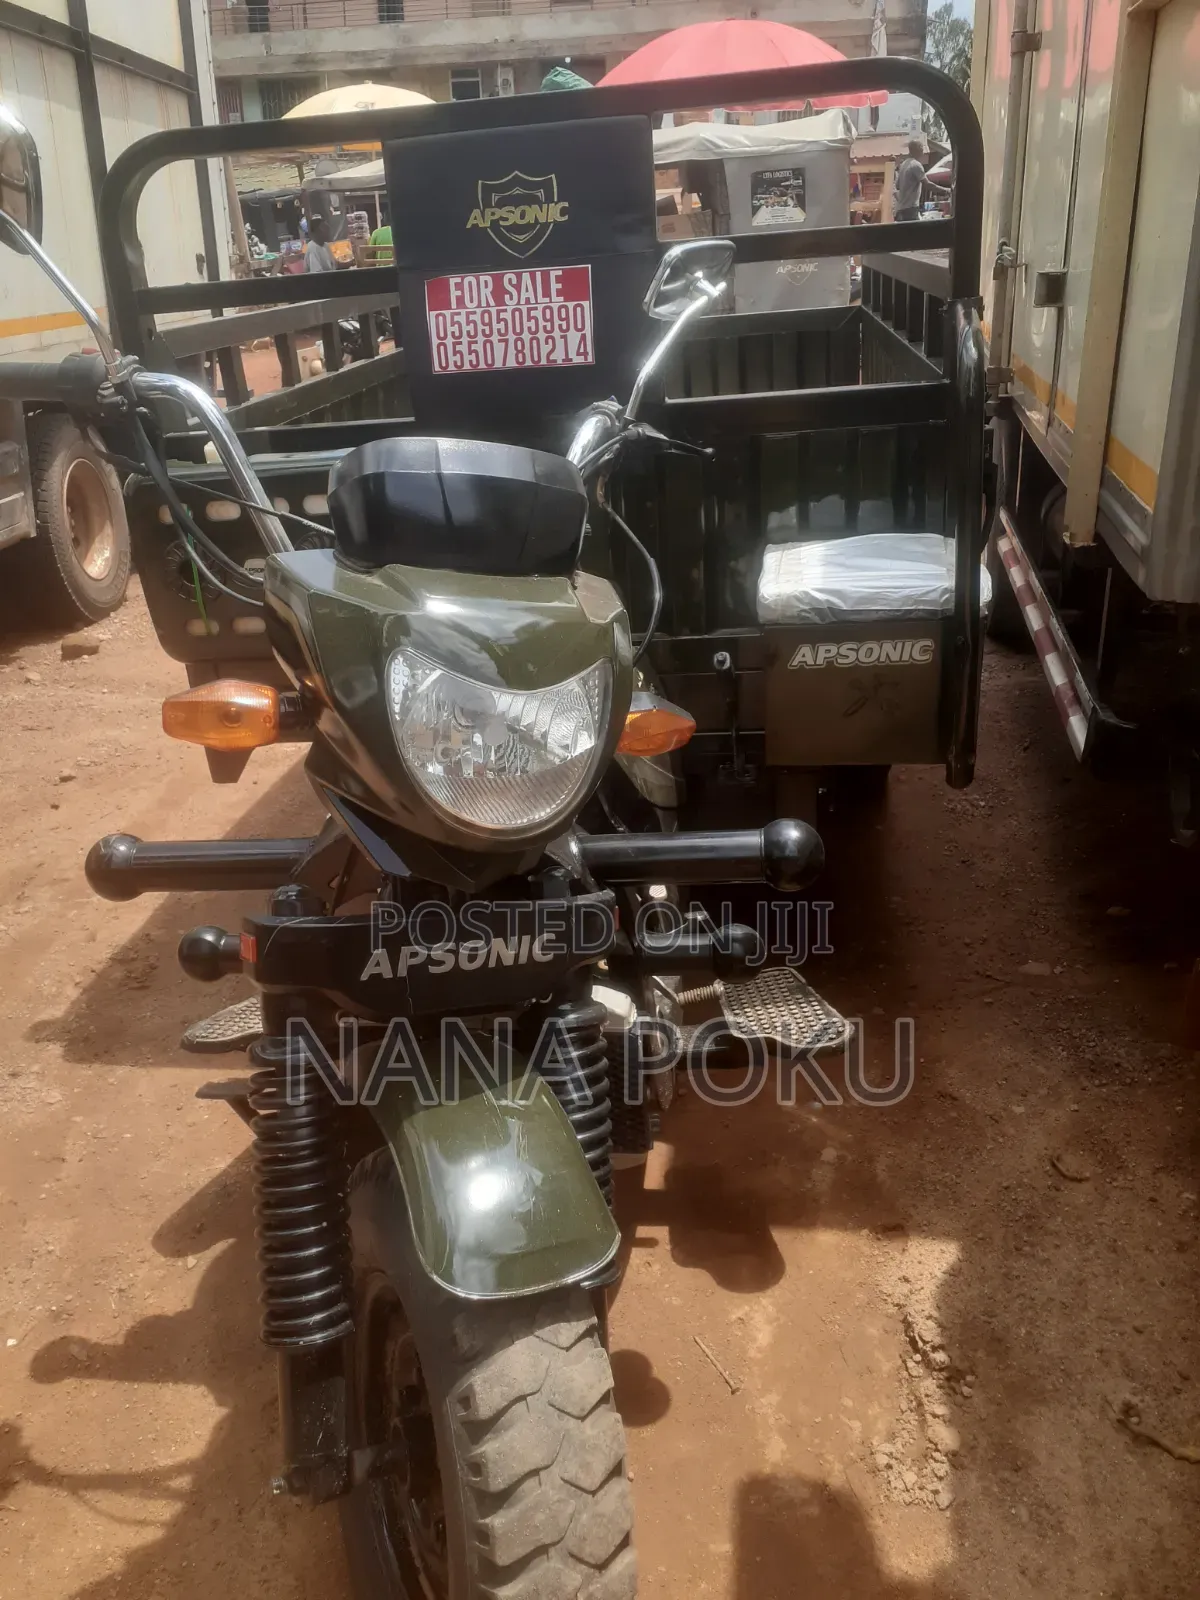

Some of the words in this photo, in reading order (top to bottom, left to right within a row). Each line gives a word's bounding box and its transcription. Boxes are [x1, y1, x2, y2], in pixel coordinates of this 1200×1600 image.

[466, 202, 569, 228] APSONIC
[776, 262, 819, 274] APSONIC
[449, 275, 496, 309] FOR
[503, 269, 564, 306] SALE
[434, 302, 586, 341] 0559505990
[436, 333, 589, 371] 0550780214
[788, 639, 935, 670] APSONIC
[360, 933, 556, 981] APSONIC
